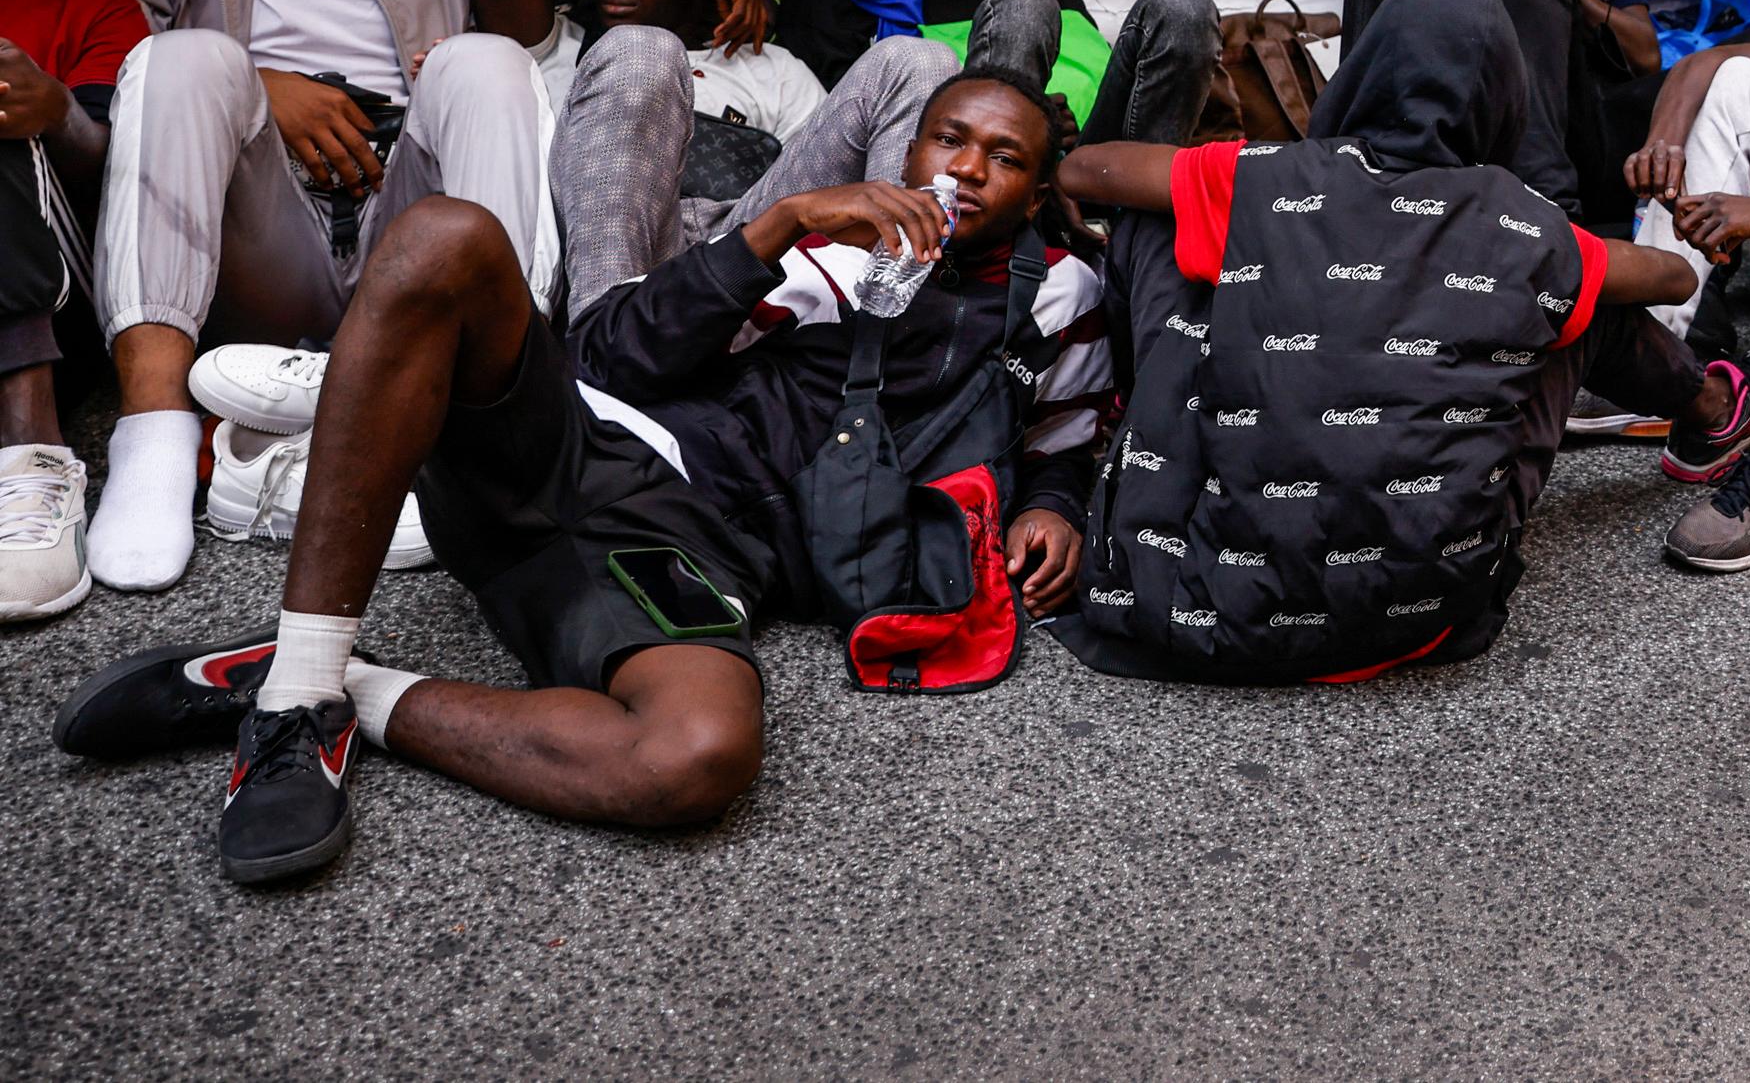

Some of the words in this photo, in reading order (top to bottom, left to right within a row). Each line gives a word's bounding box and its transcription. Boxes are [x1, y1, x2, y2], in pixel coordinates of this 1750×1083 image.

[1272, 194, 1326, 213] Coca-Cola
[1391, 196, 1447, 215] Coca-Cola
[1500, 214, 1541, 238] Coca-Cola
[1326, 263, 1385, 281] Coca-Cola
[1444, 273, 1497, 293] Coca-Cola
[1263, 334, 1320, 351] Coca-Cola
[1384, 338, 1441, 356] Coca-Cola
[1217, 409, 1260, 426] Coca-Cola
[1322, 407, 1382, 426] Coca-Cola
[34, 451, 64, 466] Reebok
[1263, 481, 1322, 498] Coca-Cola
[1386, 475, 1444, 495] Coca-Cola
[1218, 548, 1267, 567] Coca-Cola
[1325, 546, 1386, 566] Coca-Cola
[1090, 587, 1135, 606] Coca-Cola
[1386, 596, 1444, 617] Coca-Cola
[1270, 613, 1328, 627] Coca-Cola
